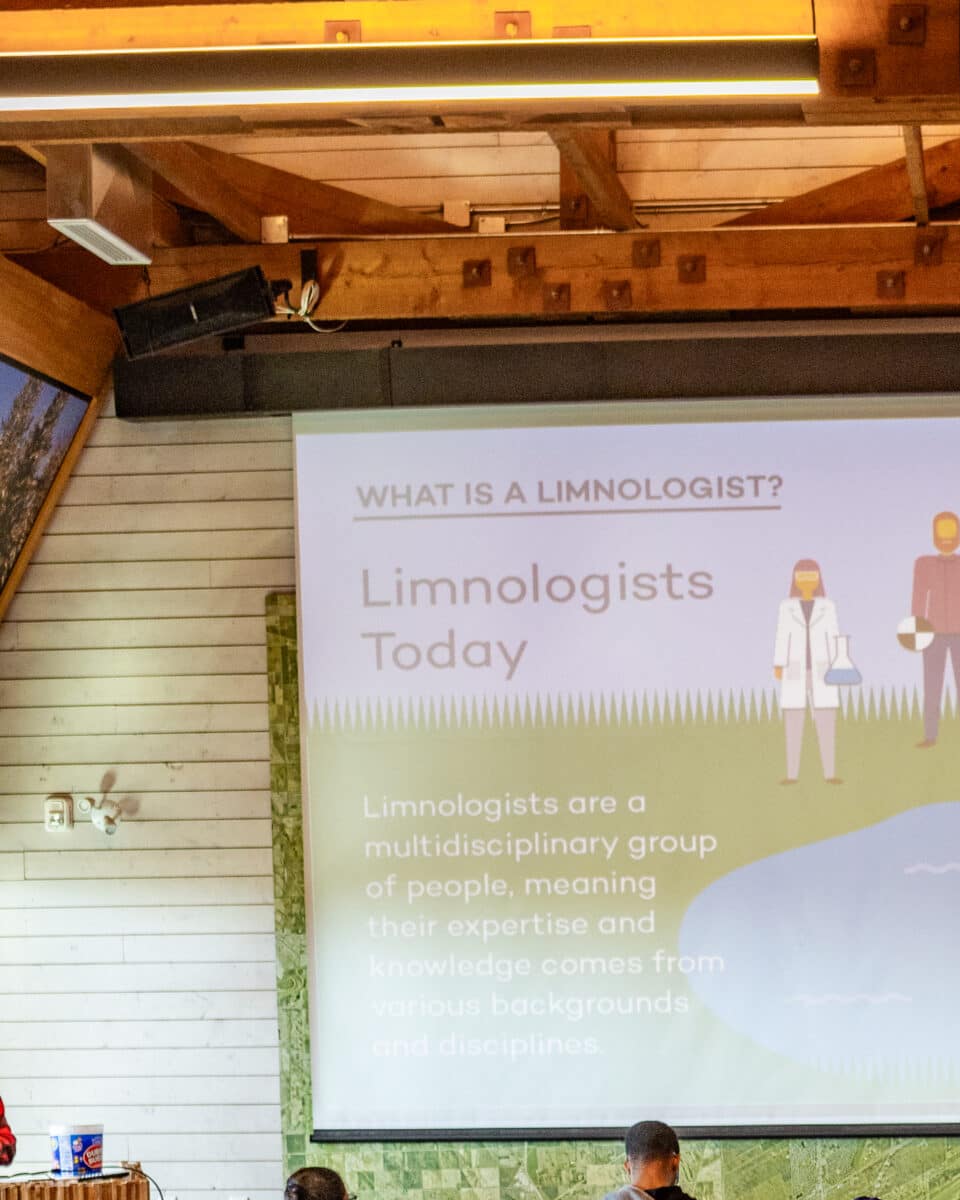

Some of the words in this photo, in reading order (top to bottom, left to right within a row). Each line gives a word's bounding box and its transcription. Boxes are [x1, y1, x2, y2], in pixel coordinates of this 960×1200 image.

[357, 483, 454, 508] WHAT
[464, 481, 493, 506] IS
[505, 480, 528, 504] A
[537, 474, 784, 504] LIMNOLOGIST?
[362, 562, 714, 614] Limnologists
[361, 628, 528, 680] Today
[366, 793, 559, 822] Limnologists
[569, 795, 616, 814] are
[627, 794, 646, 813] a
[366, 834, 618, 861] multidisciplinary
[628, 833, 717, 861] group
[366, 874, 397, 898] of
[407, 874, 514, 904] people,
[526, 874, 655, 899] meaning
[368, 914, 438, 938] their
[447, 912, 588, 943] expertise
[597, 910, 655, 934] and
[369, 953, 530, 982] knowledge
[541, 955, 643, 976] comes
[652, 949, 725, 974] from
[371, 995, 480, 1018] various
[492, 992, 689, 1020] backgrounds
[372, 1033, 429, 1057] and
[441, 1033, 603, 1061] disciplines.
